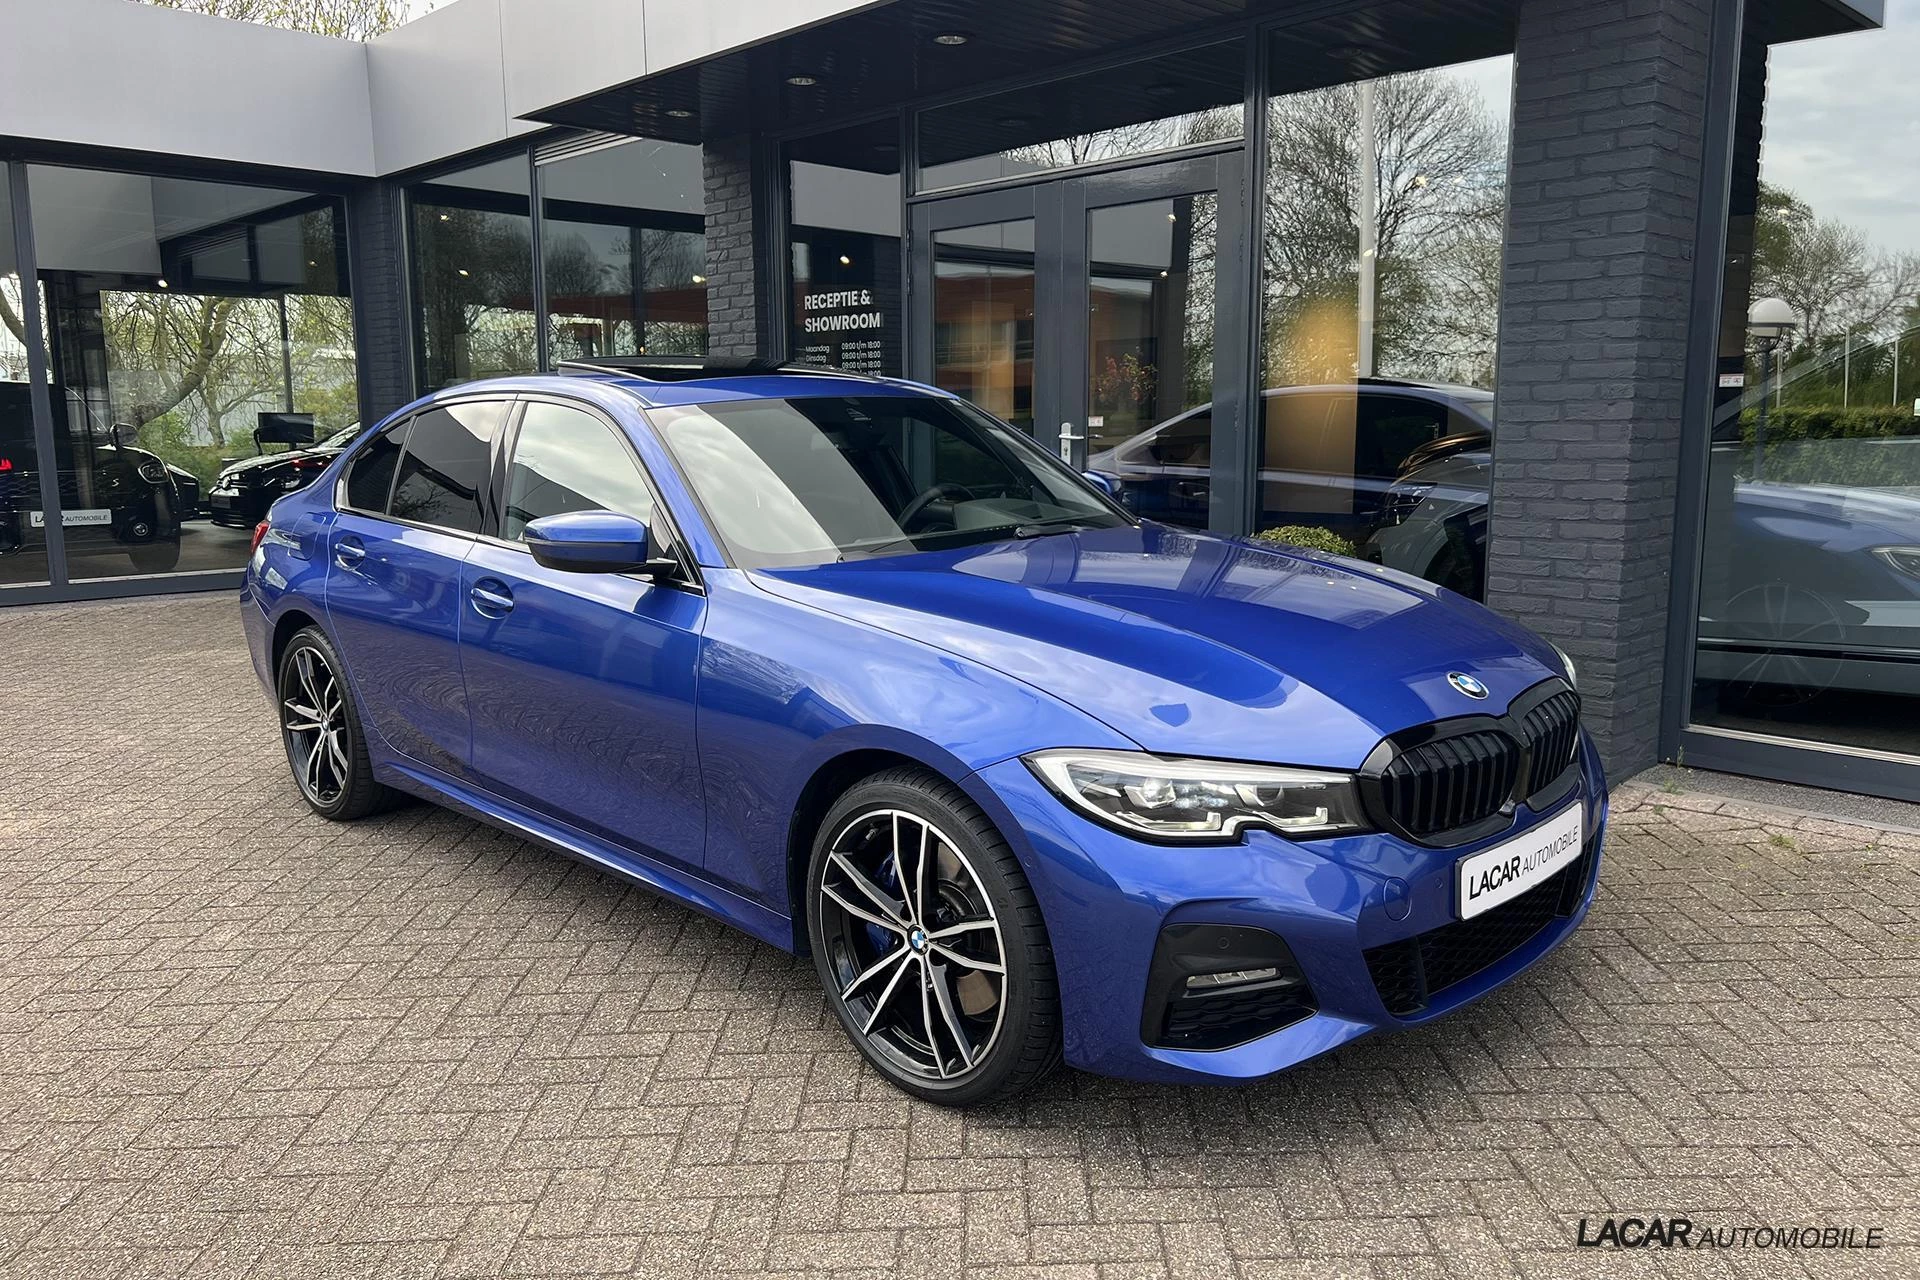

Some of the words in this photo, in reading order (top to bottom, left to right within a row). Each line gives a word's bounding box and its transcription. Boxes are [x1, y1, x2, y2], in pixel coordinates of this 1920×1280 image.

[804, 290, 858, 310] RECEPTIE
[860, 289, 871, 305] &
[804, 312, 881, 333] SHOWROOM
[805, 345, 830, 354] Maandag
[841, 342, 856, 350] 09:00
[856, 340, 867, 350] t/m
[867, 340, 881, 349] 18:00
[805, 354, 827, 363] Dinsdag
[841, 351, 856, 360] 09:00
[856, 350, 867, 360] t/m
[867, 350, 881, 359] 18:00
[841, 361, 856, 369] 09:00
[867, 360, 881, 369] 18:00
[64, 514, 108, 522] AUTOMOBILE
[1469, 854, 1521, 900] LACAR
[1521, 825, 1578, 876] AUTOMOBILE
